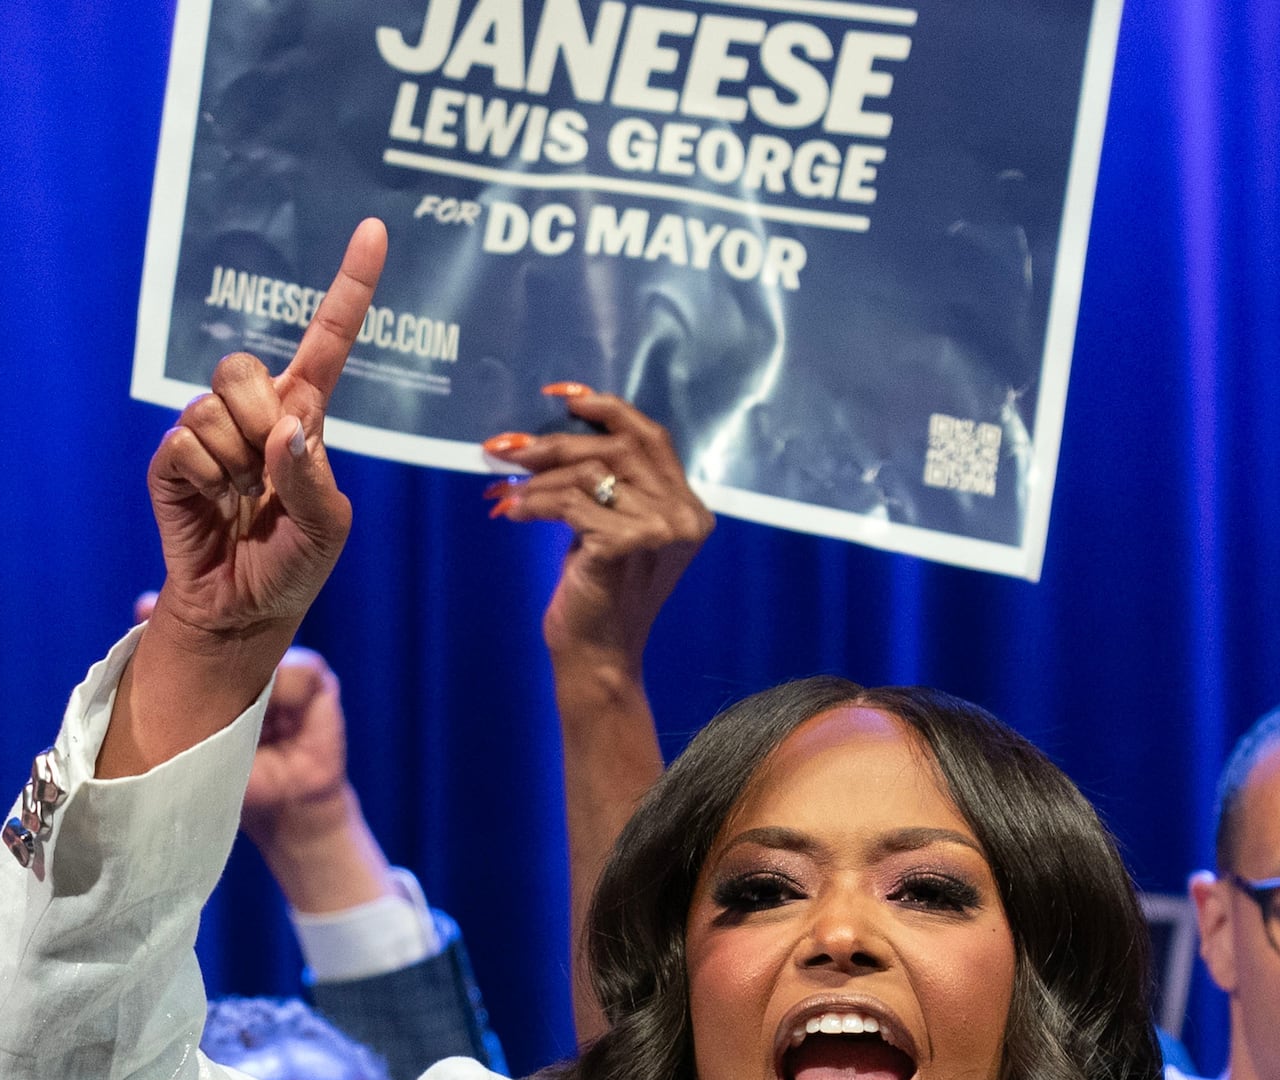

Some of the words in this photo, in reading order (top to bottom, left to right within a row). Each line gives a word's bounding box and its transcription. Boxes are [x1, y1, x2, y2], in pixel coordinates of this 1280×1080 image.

[376, 0, 911, 138] JANEESE
[389, 82, 588, 164] LEWIS
[607, 118, 887, 203] GEORGE
[414, 196, 482, 227] FOR
[483, 201, 575, 255] DC
[585, 204, 807, 290] MAYOR
